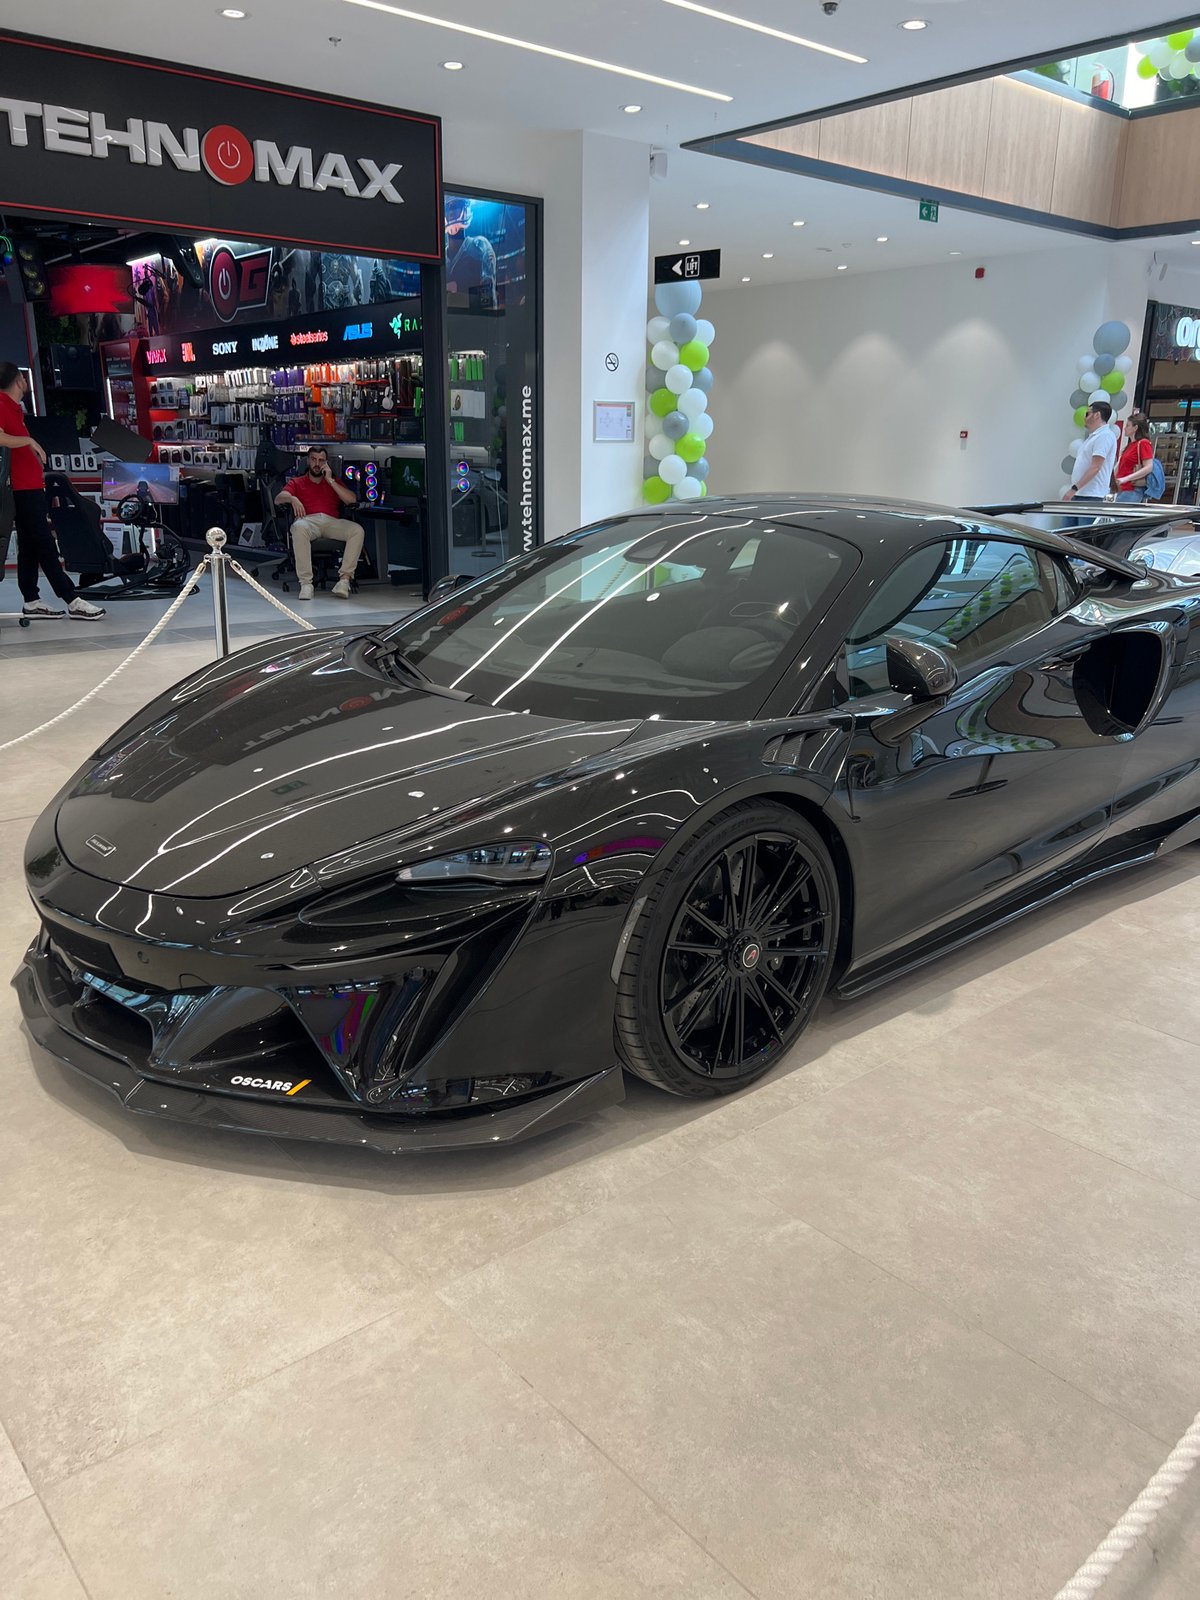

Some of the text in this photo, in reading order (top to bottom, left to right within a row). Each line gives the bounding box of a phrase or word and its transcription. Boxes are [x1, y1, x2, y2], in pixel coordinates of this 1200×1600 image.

[0, 97, 404, 204] TEHNOMAX
[343, 322, 373, 341] ASUS
[212, 341, 238, 355] SONY
[230, 1076, 293, 1091] OSCARS
